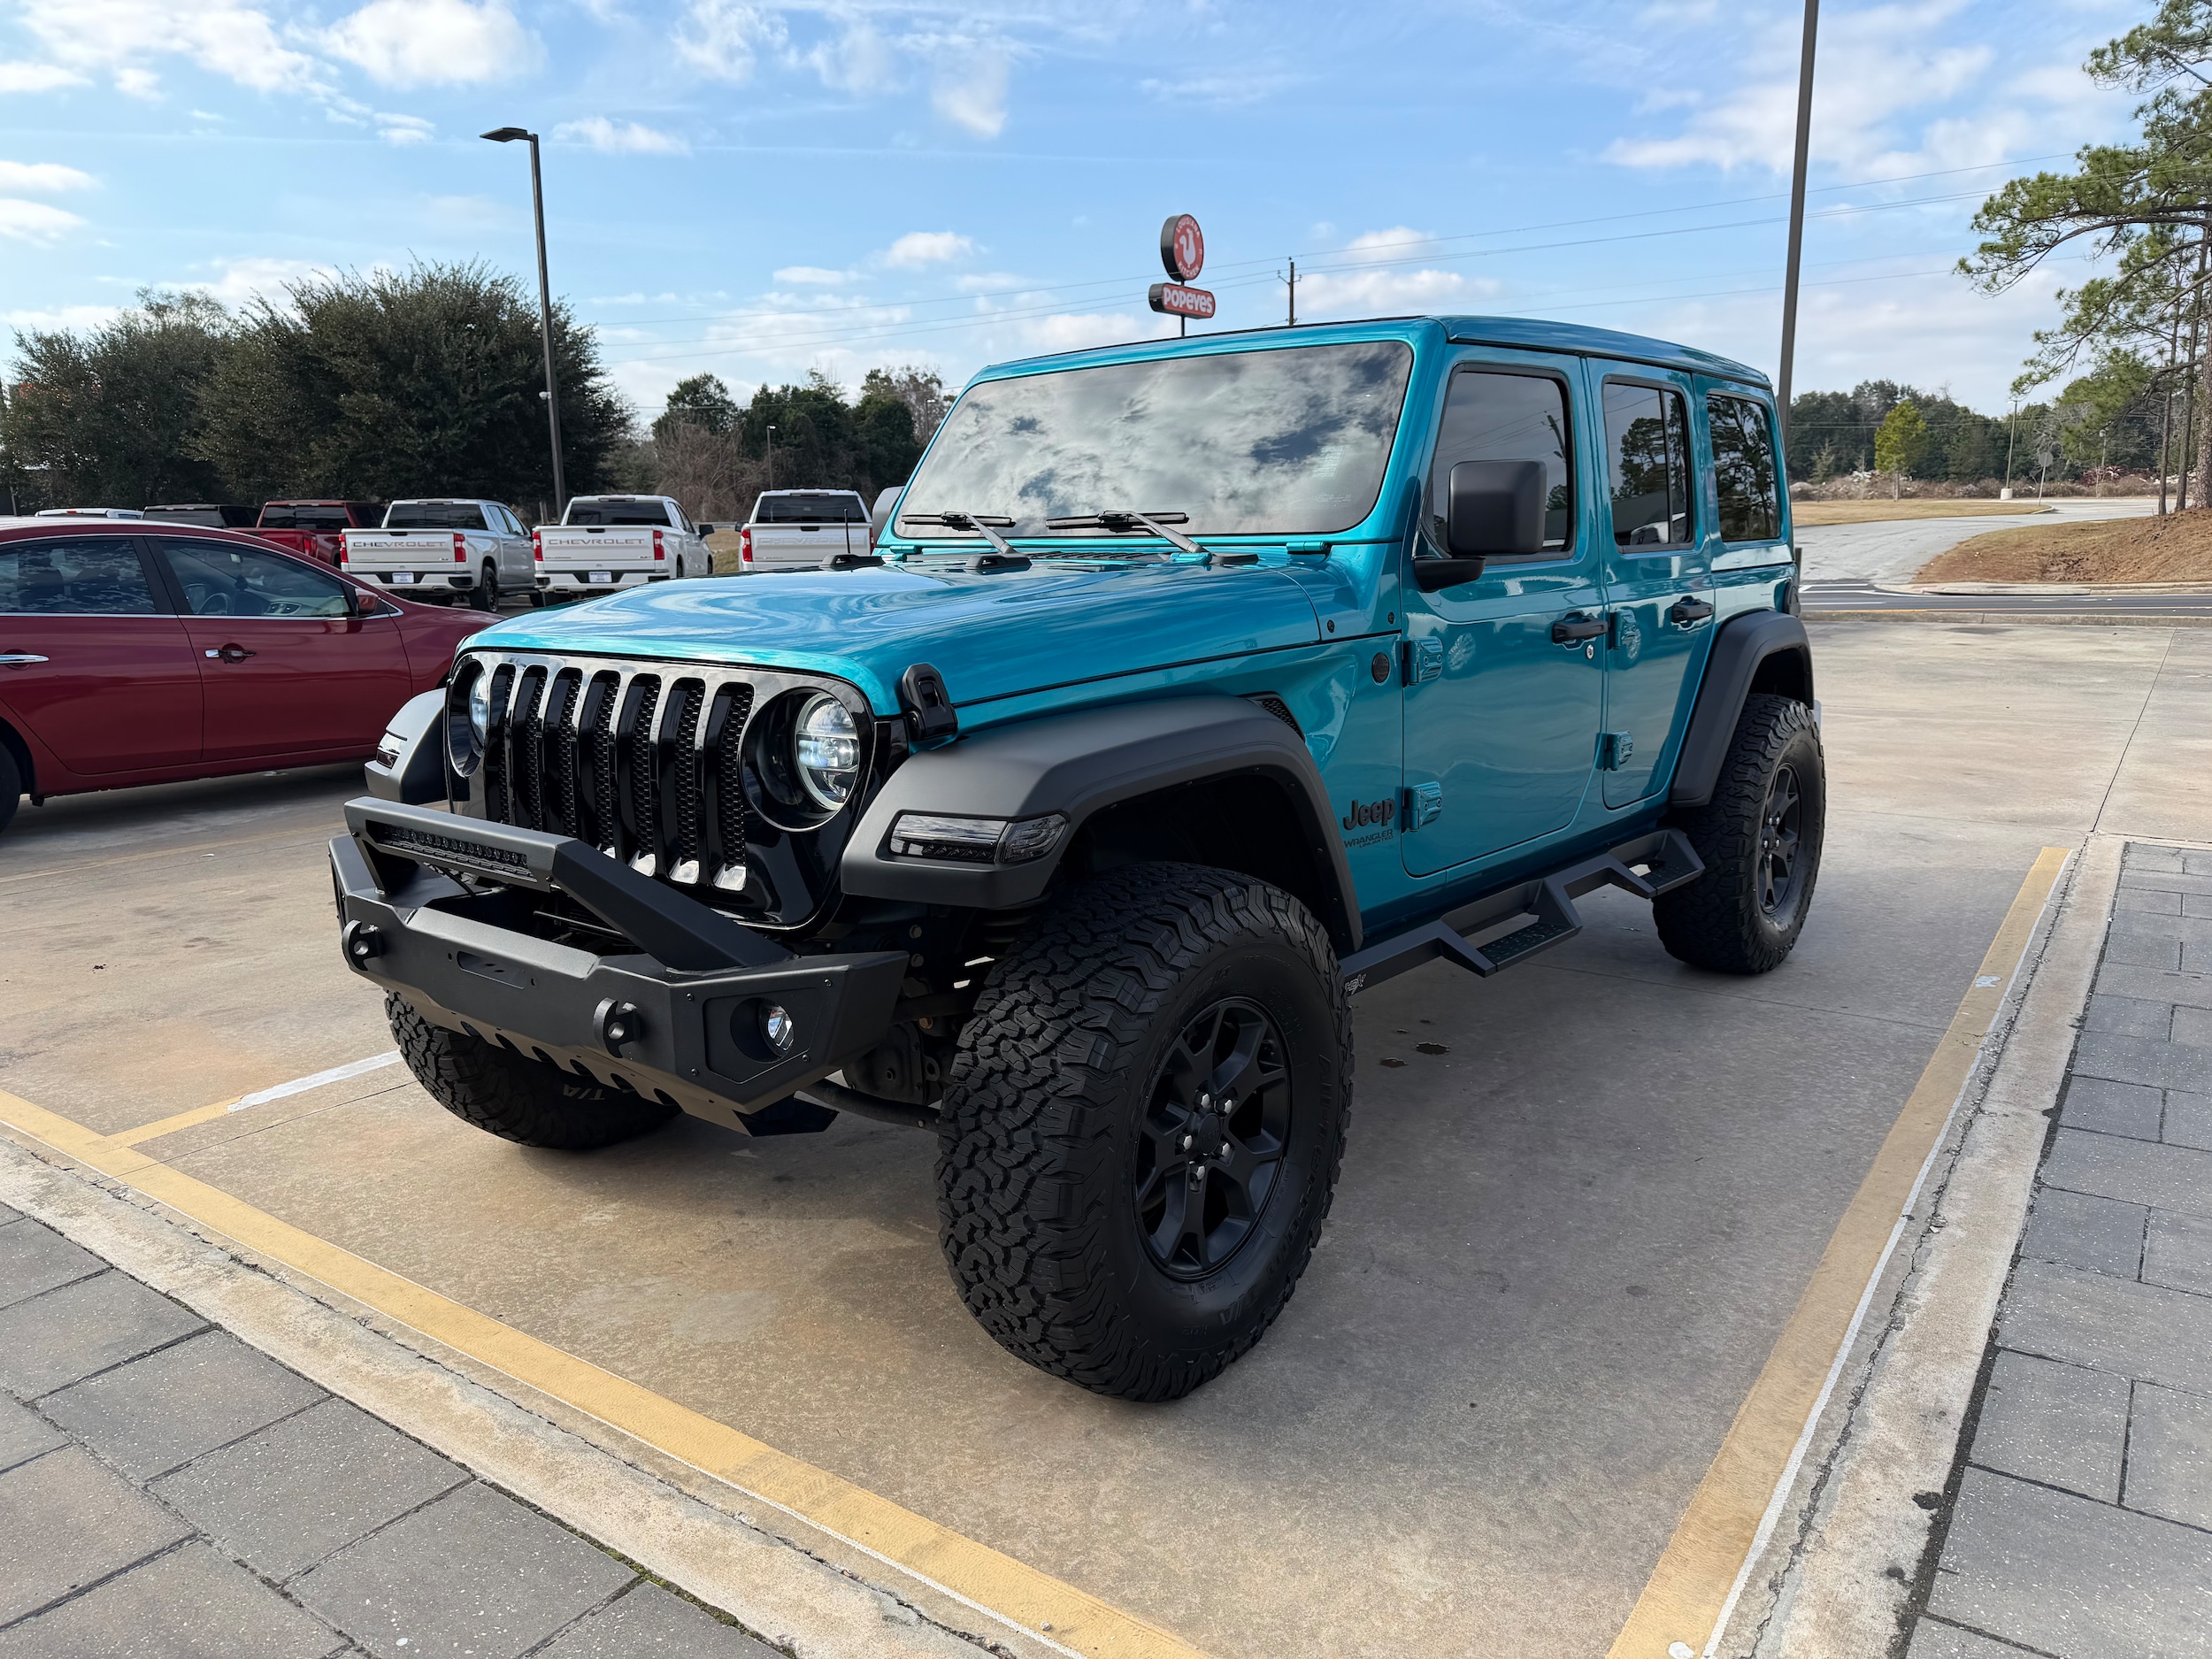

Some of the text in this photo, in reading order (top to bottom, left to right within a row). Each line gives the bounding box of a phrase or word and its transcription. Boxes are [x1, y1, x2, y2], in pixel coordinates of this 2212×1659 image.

[1178, 261, 1200, 278] KITCHEN
[1343, 798, 1395, 831] Jeep
[1344, 829, 1394, 849] WRANGLER
[1359, 835, 1394, 849] UNLIMITED
[563, 1083, 605, 1101] T/A
